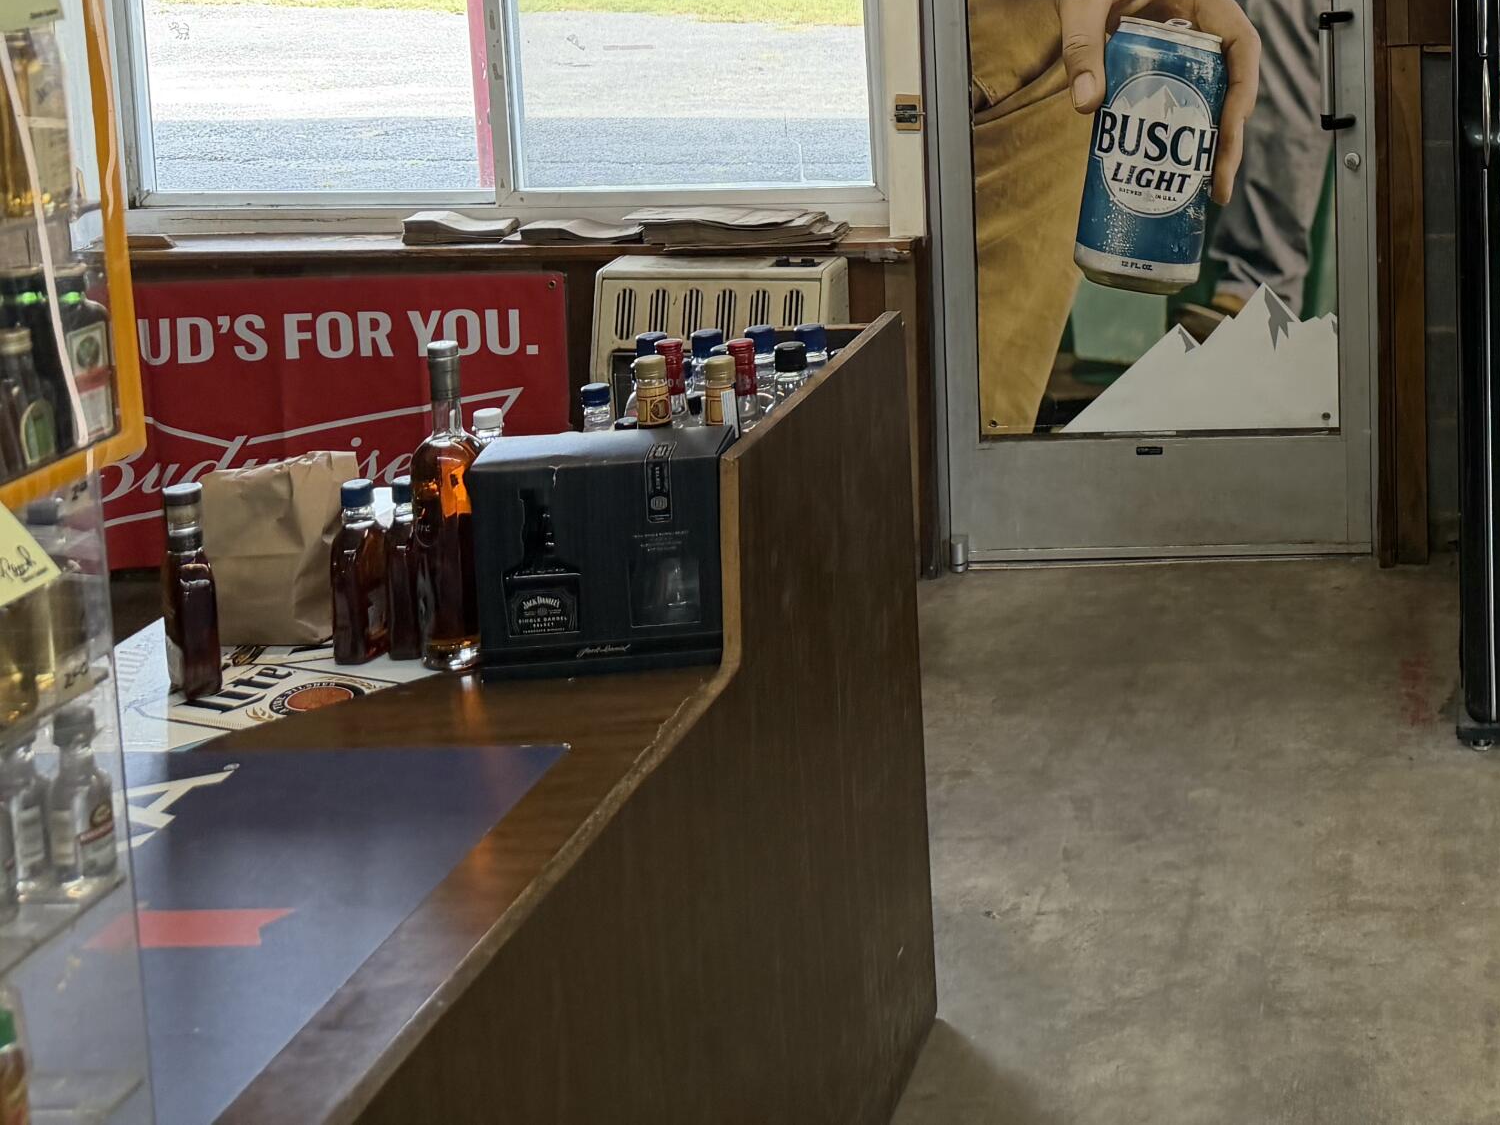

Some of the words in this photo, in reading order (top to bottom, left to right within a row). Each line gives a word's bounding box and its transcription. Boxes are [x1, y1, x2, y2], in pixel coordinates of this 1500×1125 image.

[1097, 110, 1218, 172] BUSCH
[1111, 162, 1191, 194] LIGHT
[138, 313, 268, 366] UD'S
[284, 311, 393, 360] FOR
[407, 309, 538, 357] YOU.
